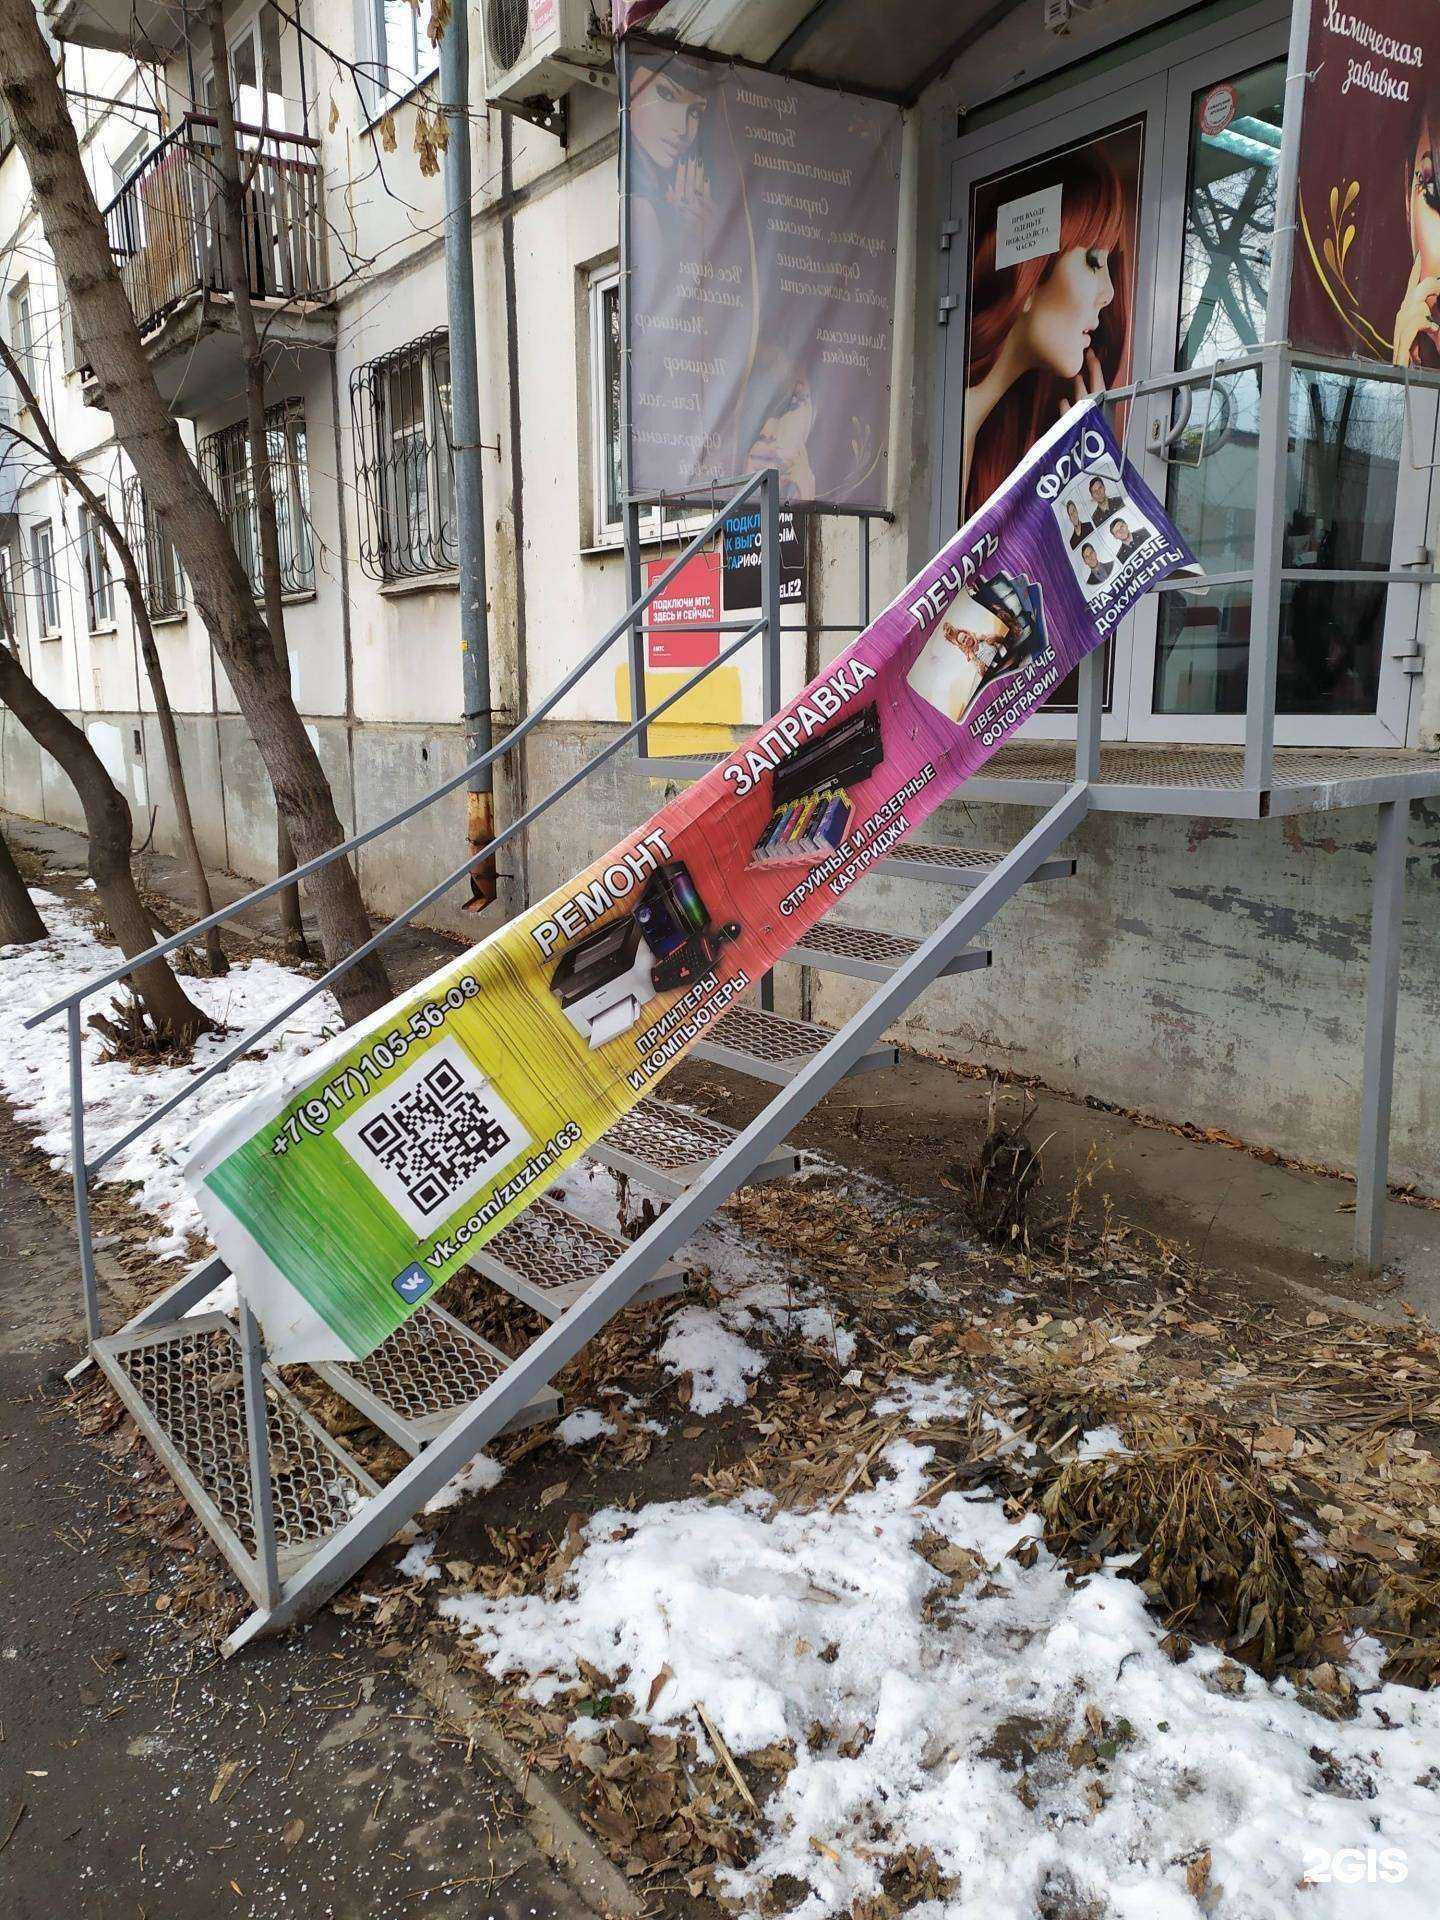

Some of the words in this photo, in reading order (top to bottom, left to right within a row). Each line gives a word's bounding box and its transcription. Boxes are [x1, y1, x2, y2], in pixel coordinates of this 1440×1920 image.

[1323, 0, 1423, 67] Химическая
[1342, 58, 1410, 102] завивка
[653, 598, 693, 611] ПОДКЛЮЧИ
[694, 596, 711, 606] МТС
[653, 610, 676, 623] ЗДЕСЬ
[677, 610, 682, 619] И
[683, 606, 715, 620] СЕЙЧАС!
[779, 578, 802, 598] ELE2
[907, 532, 999, 632] ПЕЧАТЬ
[1089, 592, 1113, 617] НА
[1112, 534, 1170, 594] ЛЮБЫЕ
[1094, 547, 1184, 635] ДОКУМЕНТЫ
[723, 657, 877, 797] ЗАПРАВКА
[968, 678, 1026, 738] ЦВЕТНЫЕ
[1035, 645, 1057, 667] Ч/Б
[981, 666, 1060, 747] ФОТОГРАФИИ
[778, 842, 854, 918] СТРУЙНЫЕ
[851, 829, 865, 847] И
[865, 762, 937, 838] ЛАЗЕРНЫЕ
[828, 814, 911, 896] КАРТРИДЖИ
[531, 827, 673, 958] РЕМОНТ
[626, 1069, 645, 1091] И
[641, 969, 751, 1077] КОМПЬЮТЕРЫ
[635, 970, 720, 1056] ПРИНТЕРЫ
[272, 976, 481, 1155] +7(917)105-56-08
[425, 1121, 583, 1269] vk.com/zuzin163
